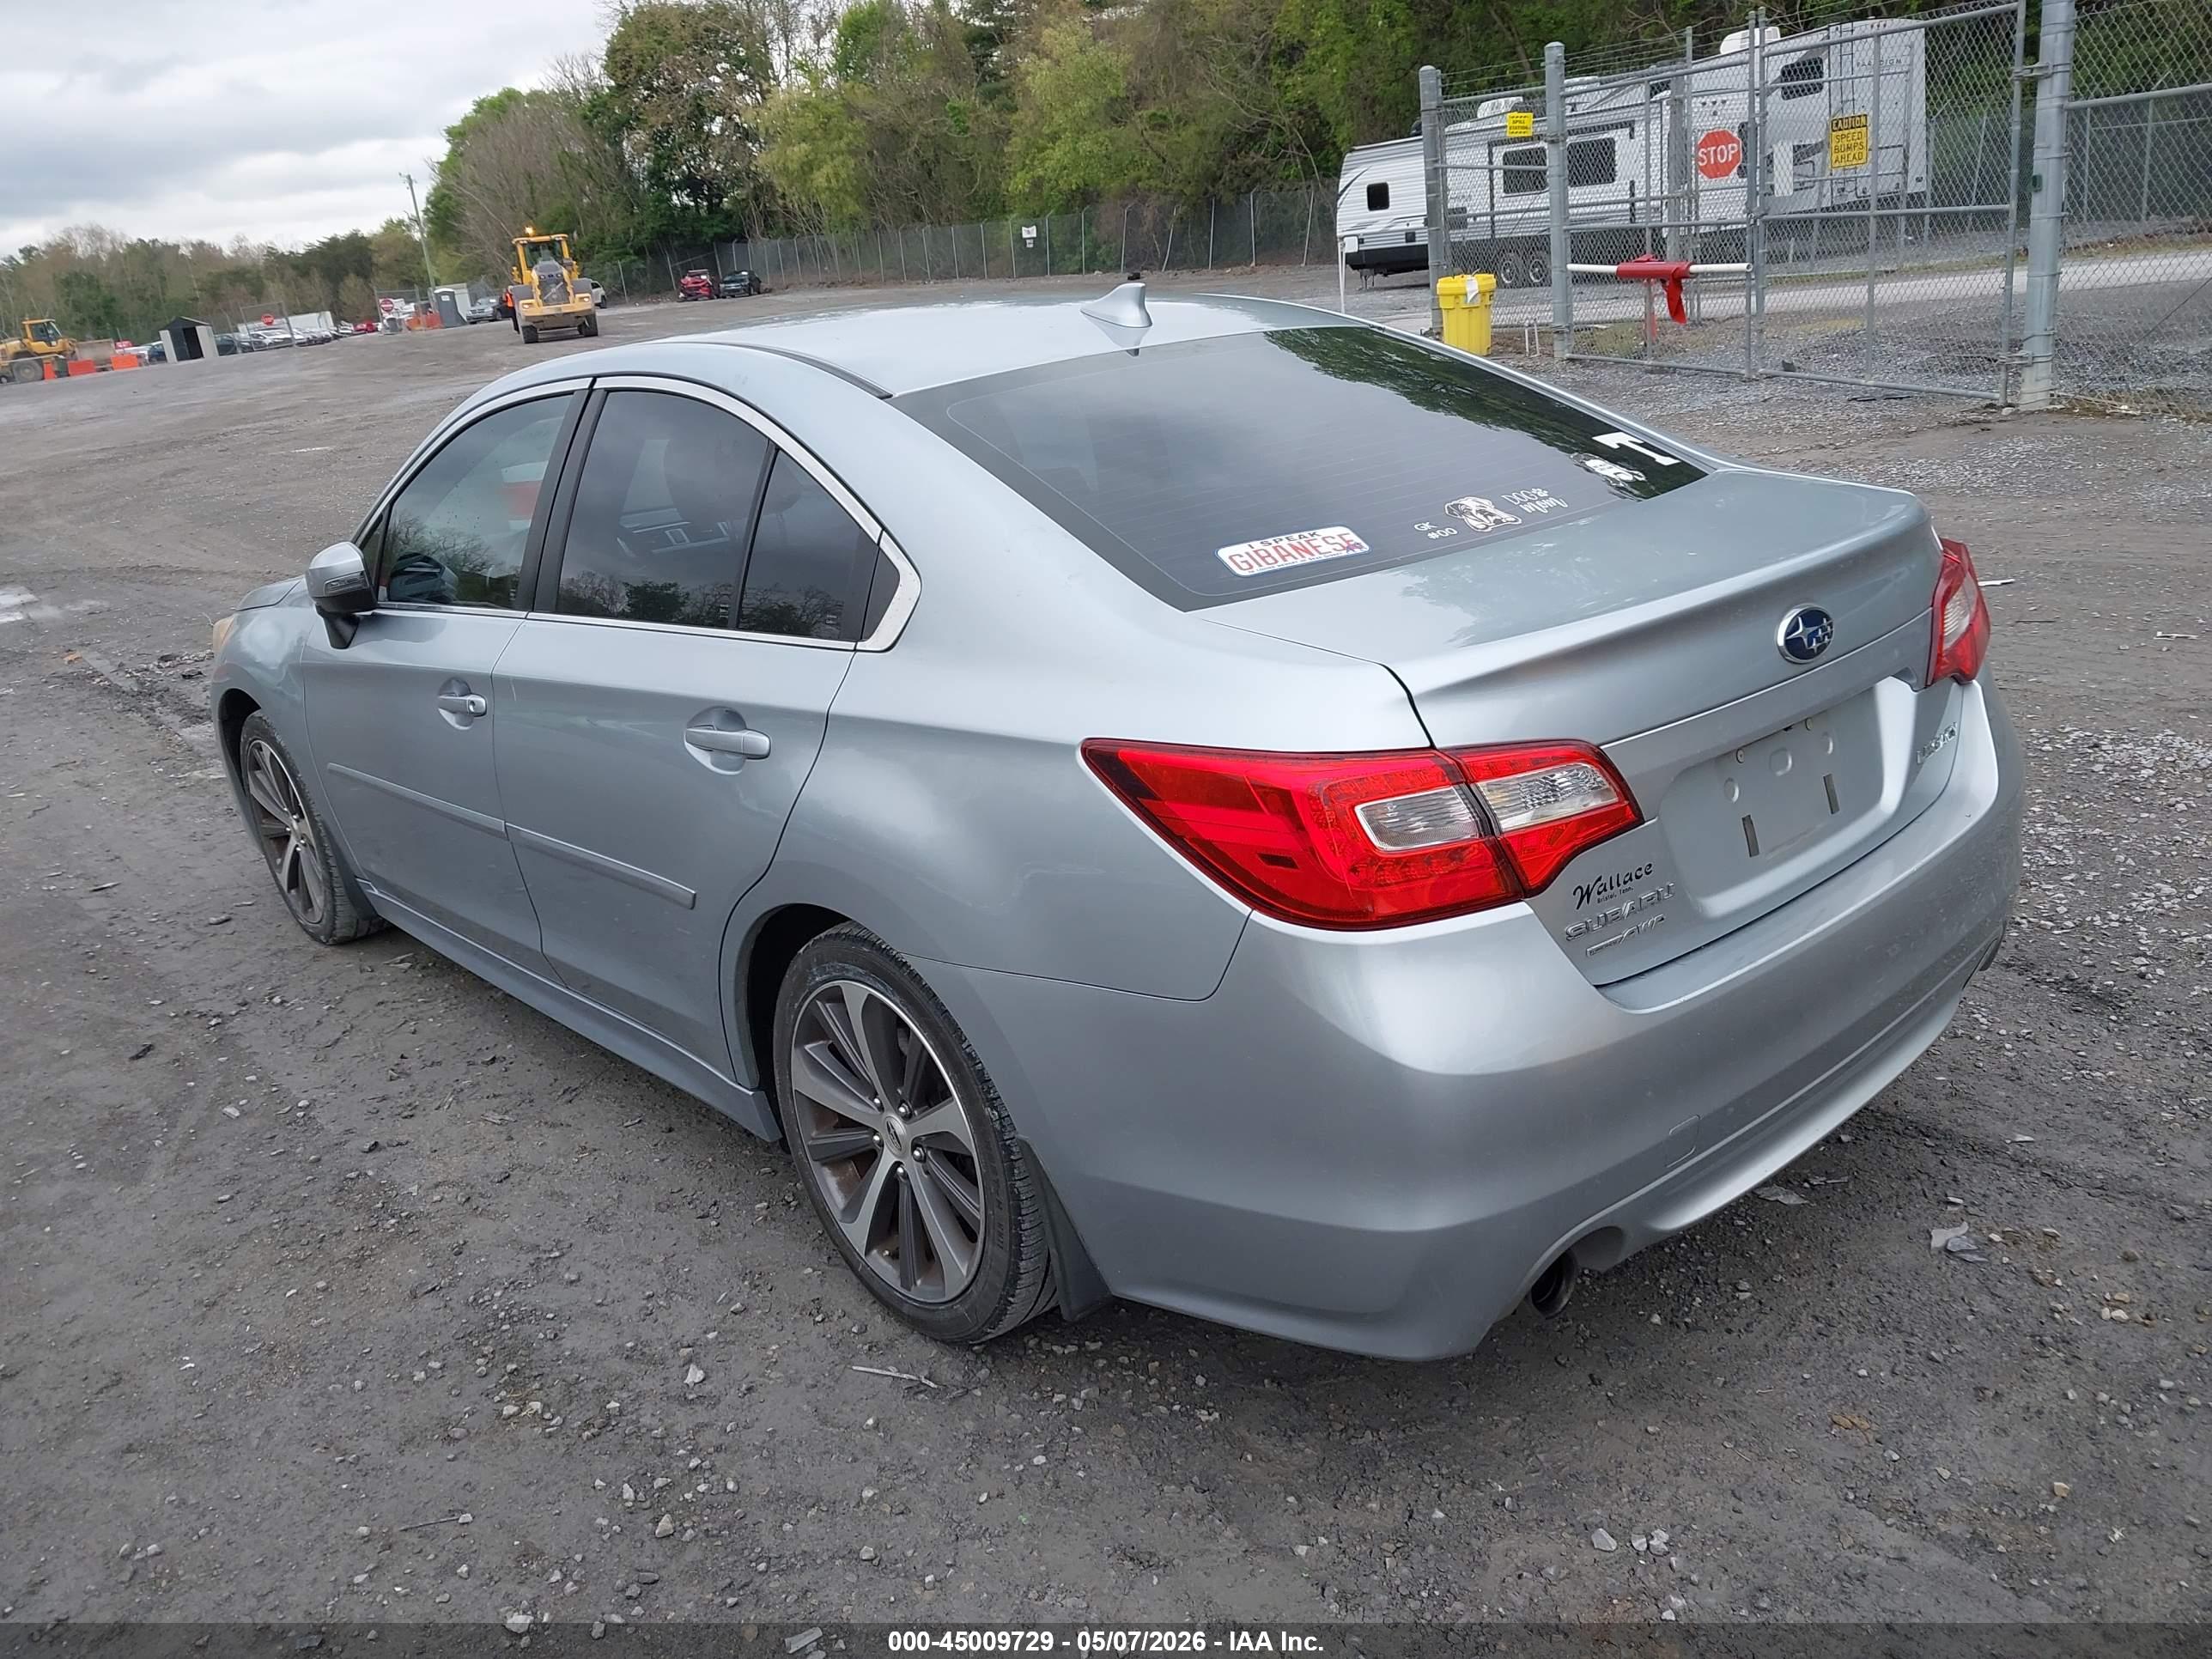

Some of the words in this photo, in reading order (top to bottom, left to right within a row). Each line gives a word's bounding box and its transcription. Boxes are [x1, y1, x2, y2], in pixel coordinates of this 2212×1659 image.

[1856, 58, 1903, 67] PARDIGM
[1832, 116, 1866, 131] CAUTION
[1835, 131, 1863, 143] SPEED
[1698, 143, 1738, 166] STOP
[1834, 141, 1864, 154] BUMPS
[1834, 151, 1863, 164] AHEAD
[1260, 531, 1322, 548] SPEAK
[1228, 532, 1356, 572] GIBANESE
[1572, 862, 1653, 910] Wallace
[1565, 882, 1675, 942] SUBARU
